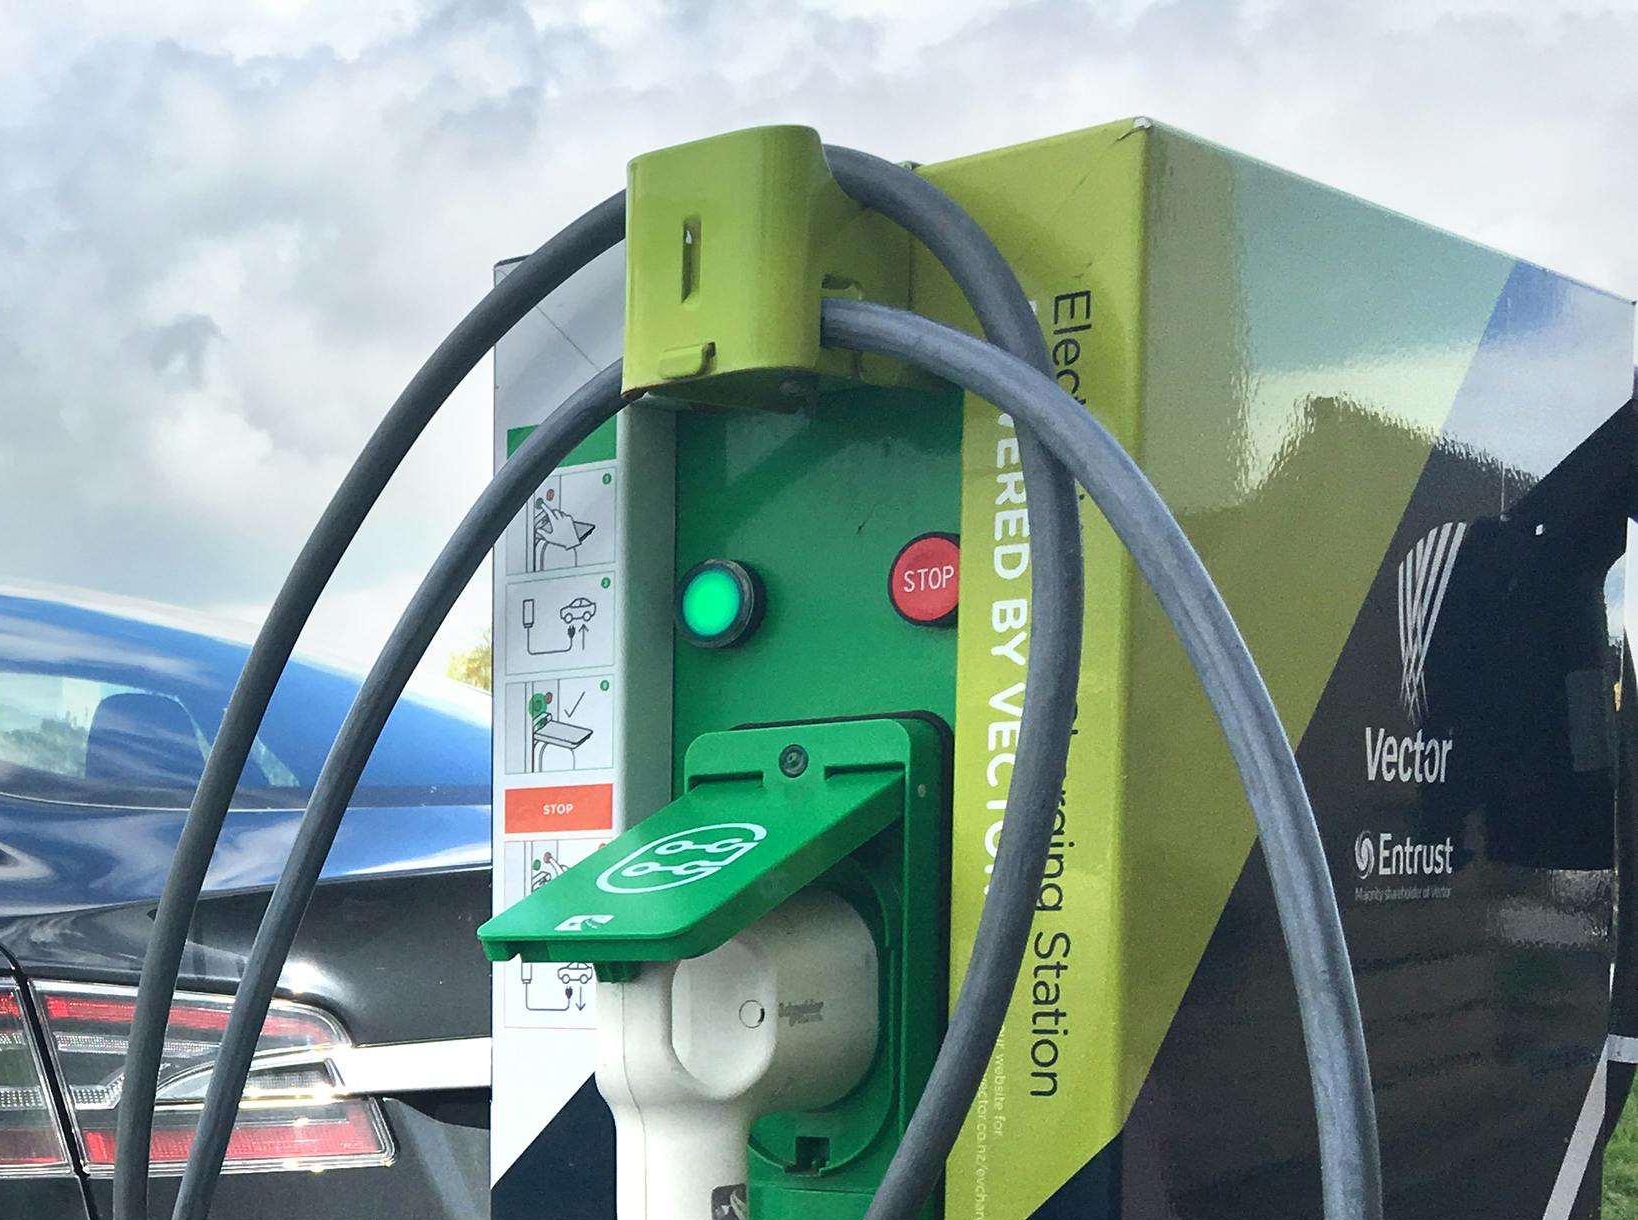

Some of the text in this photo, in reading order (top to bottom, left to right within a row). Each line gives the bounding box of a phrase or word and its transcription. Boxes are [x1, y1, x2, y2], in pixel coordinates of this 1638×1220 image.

[903, 565, 955, 593] STOP
[991, 598, 1028, 666] BY
[1365, 726, 1453, 784] Vector
[542, 802, 574, 816] STOP
[1378, 832, 1454, 876] Entrust
[1030, 931, 1071, 1097] Station
[993, 1053, 1006, 1111] website
[992, 1116, 1007, 1137] for
